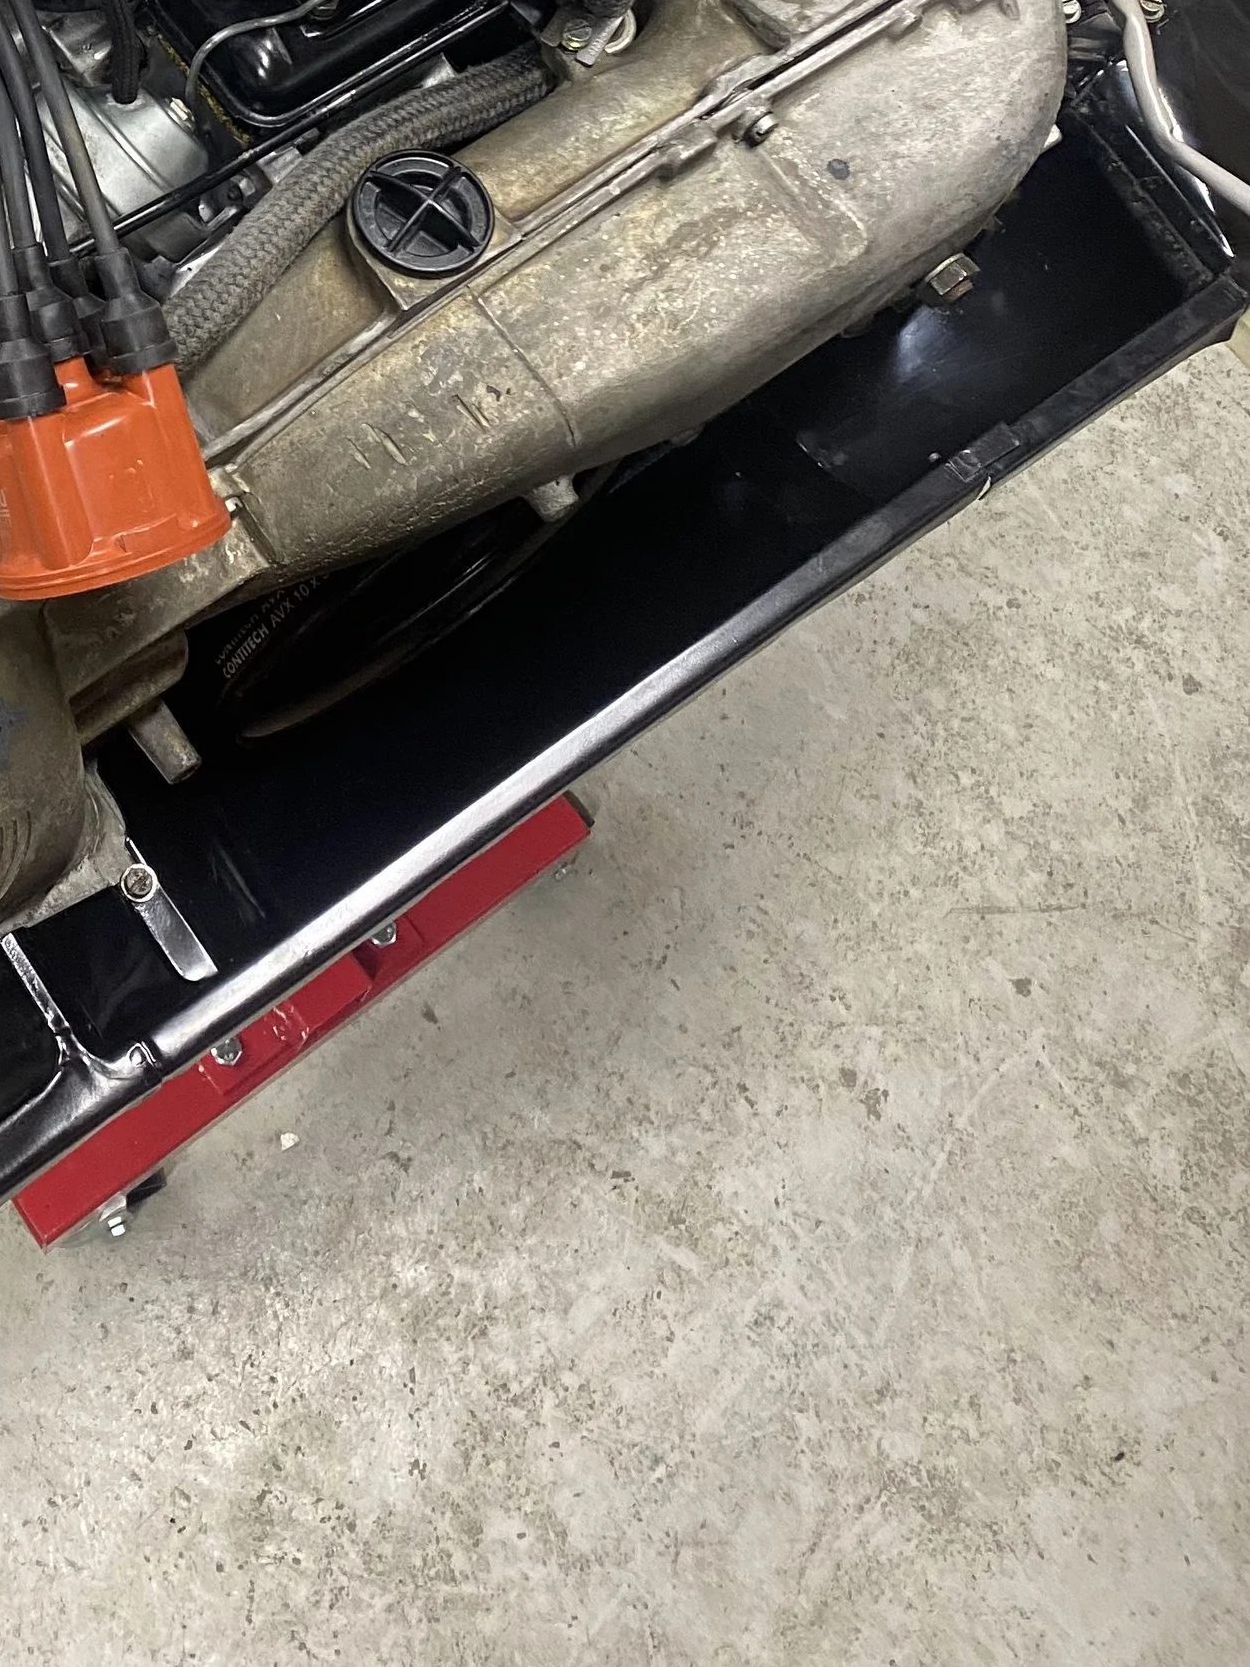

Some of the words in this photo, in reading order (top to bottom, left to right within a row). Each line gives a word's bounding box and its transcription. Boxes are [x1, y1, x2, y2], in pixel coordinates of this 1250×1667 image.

[222, 623, 270, 679] CONTITECH
[270, 597, 295, 628] AVX
[293, 583, 310, 602] 10
